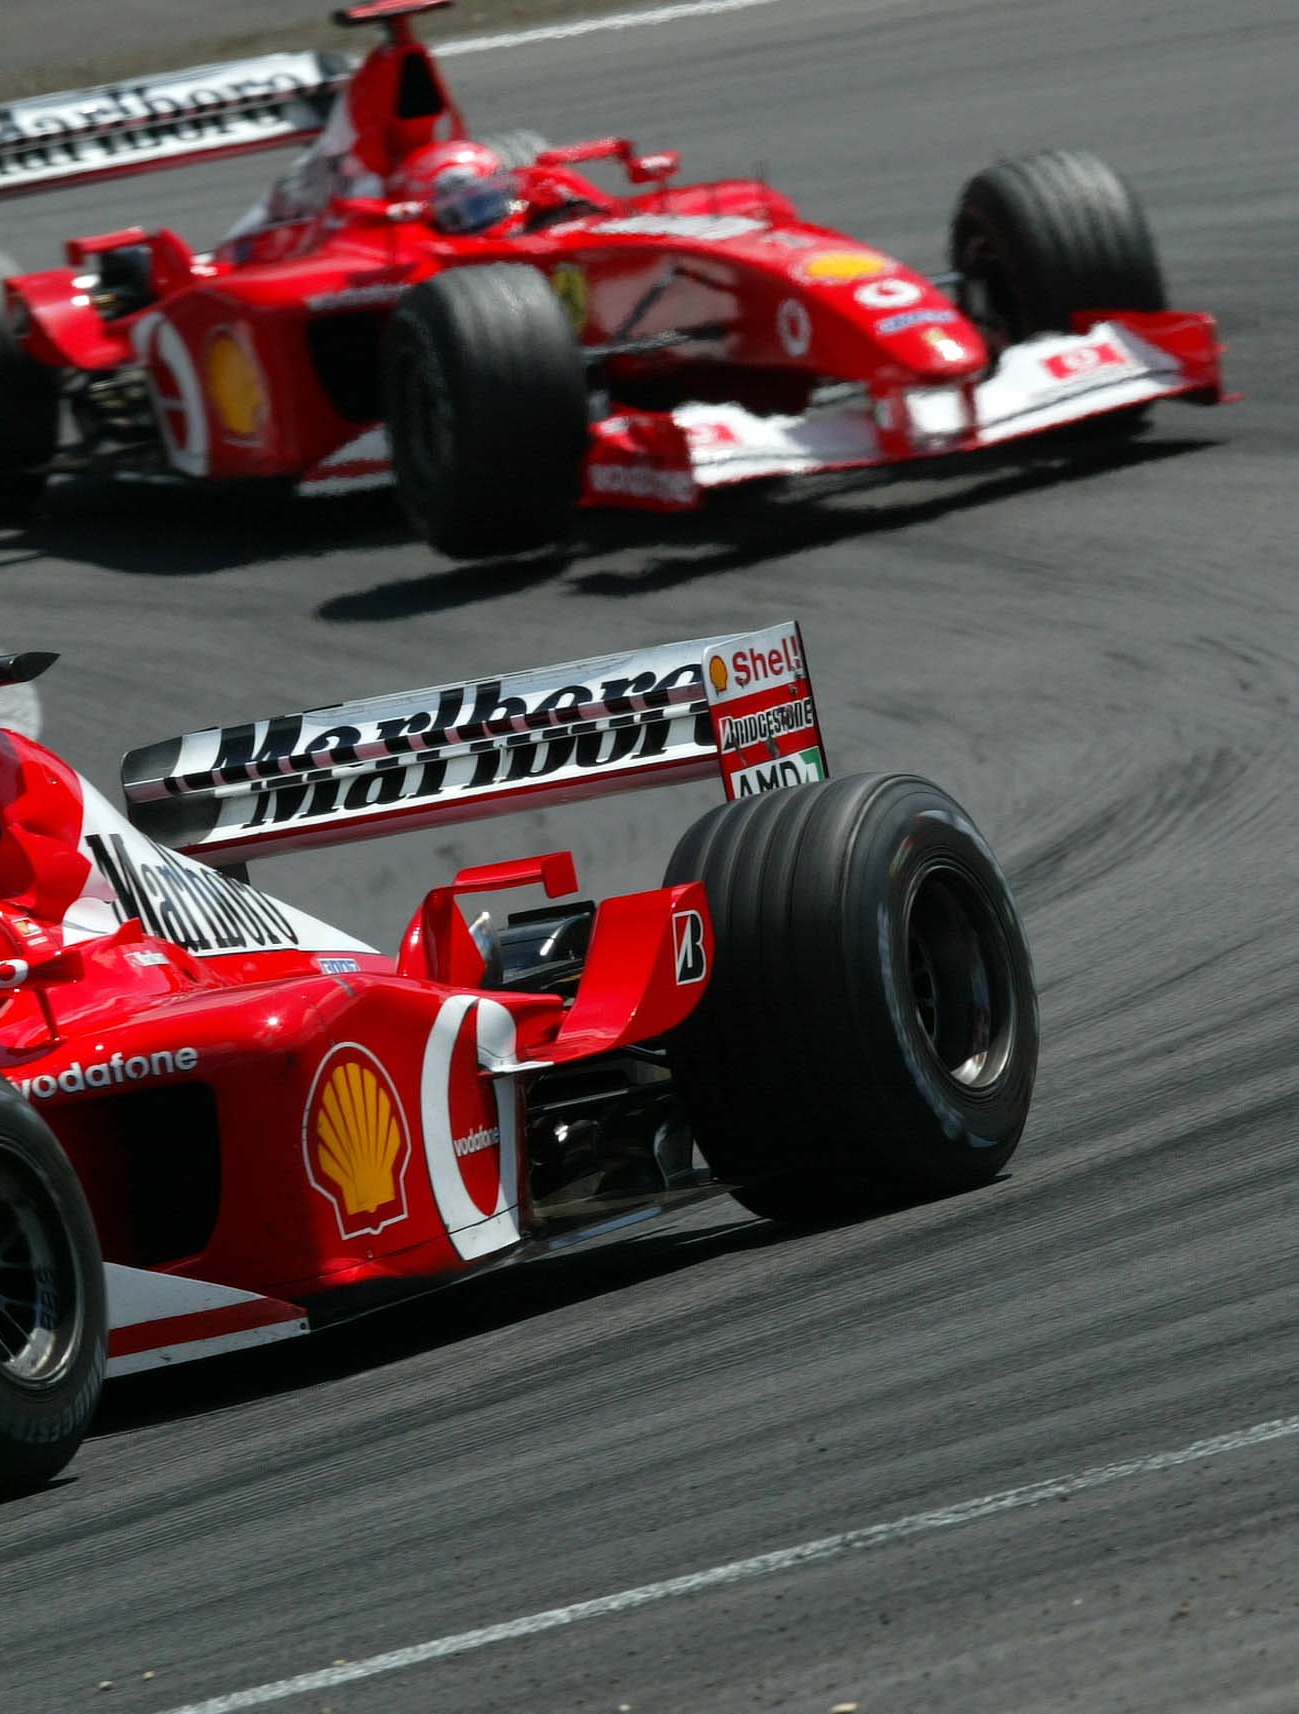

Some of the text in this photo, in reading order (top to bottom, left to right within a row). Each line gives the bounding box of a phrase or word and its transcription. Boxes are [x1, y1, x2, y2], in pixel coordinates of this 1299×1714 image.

[732, 635, 802, 687] Shell
[719, 697, 814, 752] BRIDGESTONE
[738, 760, 801, 798] AMD
[85, 833, 299, 952] Marlboro
[7, 1047, 198, 1100] vodafone
